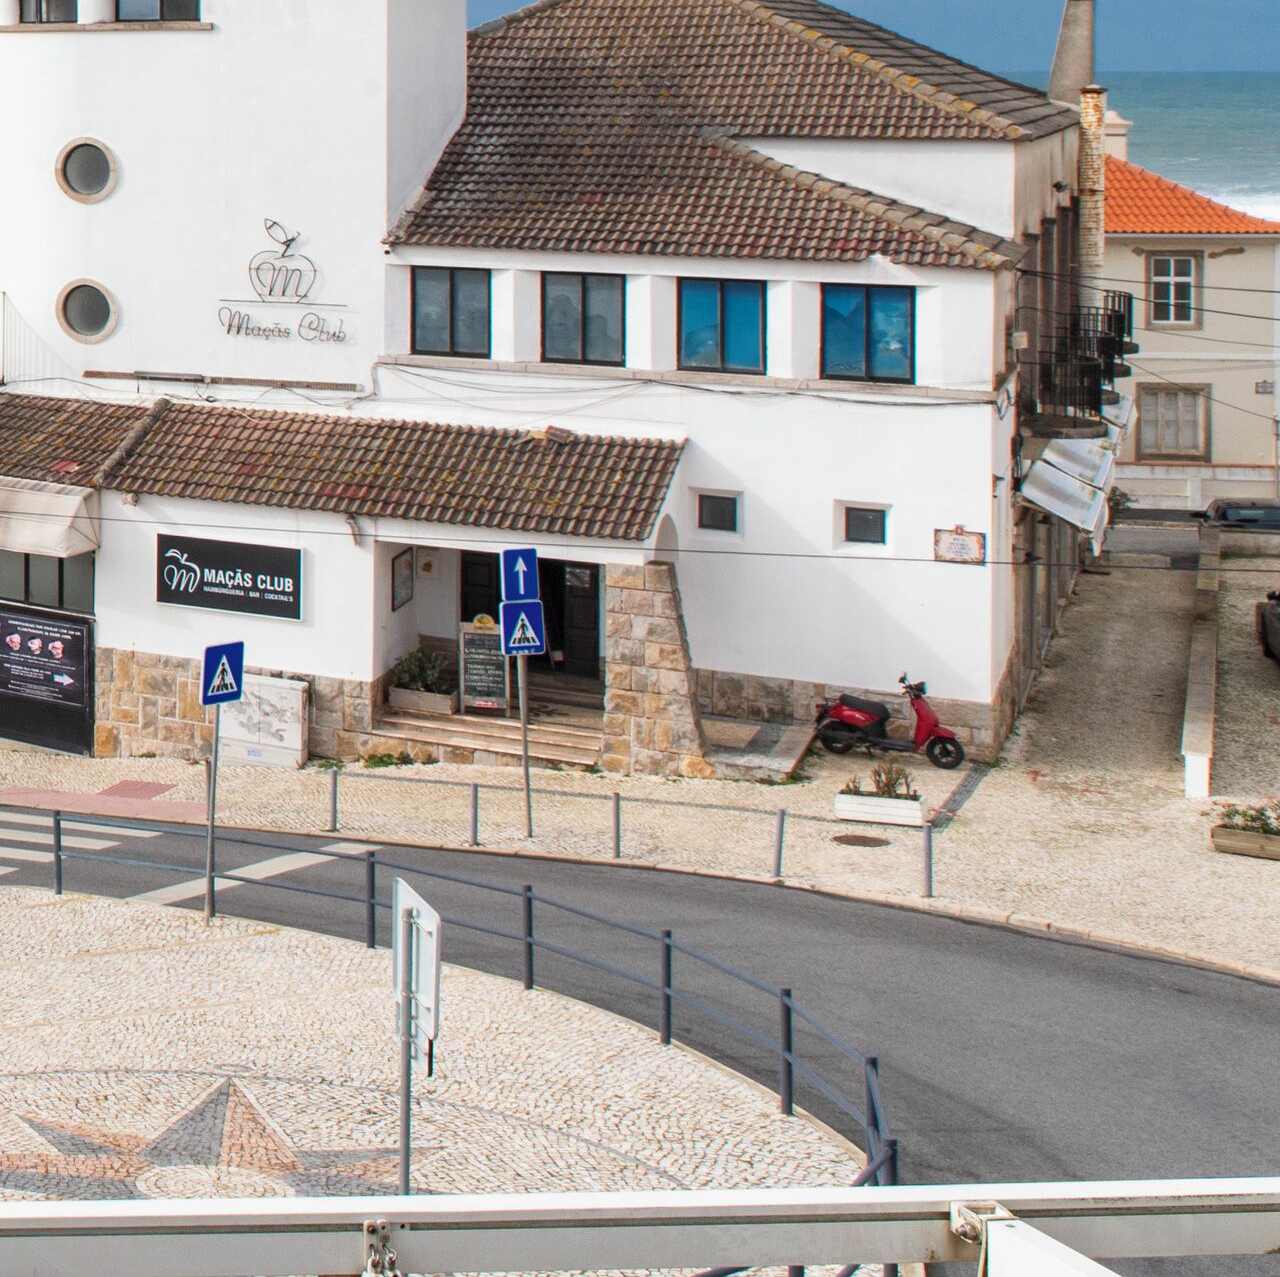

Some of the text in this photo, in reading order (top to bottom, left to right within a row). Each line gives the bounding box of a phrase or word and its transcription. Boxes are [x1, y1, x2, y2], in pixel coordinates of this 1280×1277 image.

[218, 307, 347, 342] Maçãs Club
[203, 568, 294, 593] MAÇÃS CLUB
